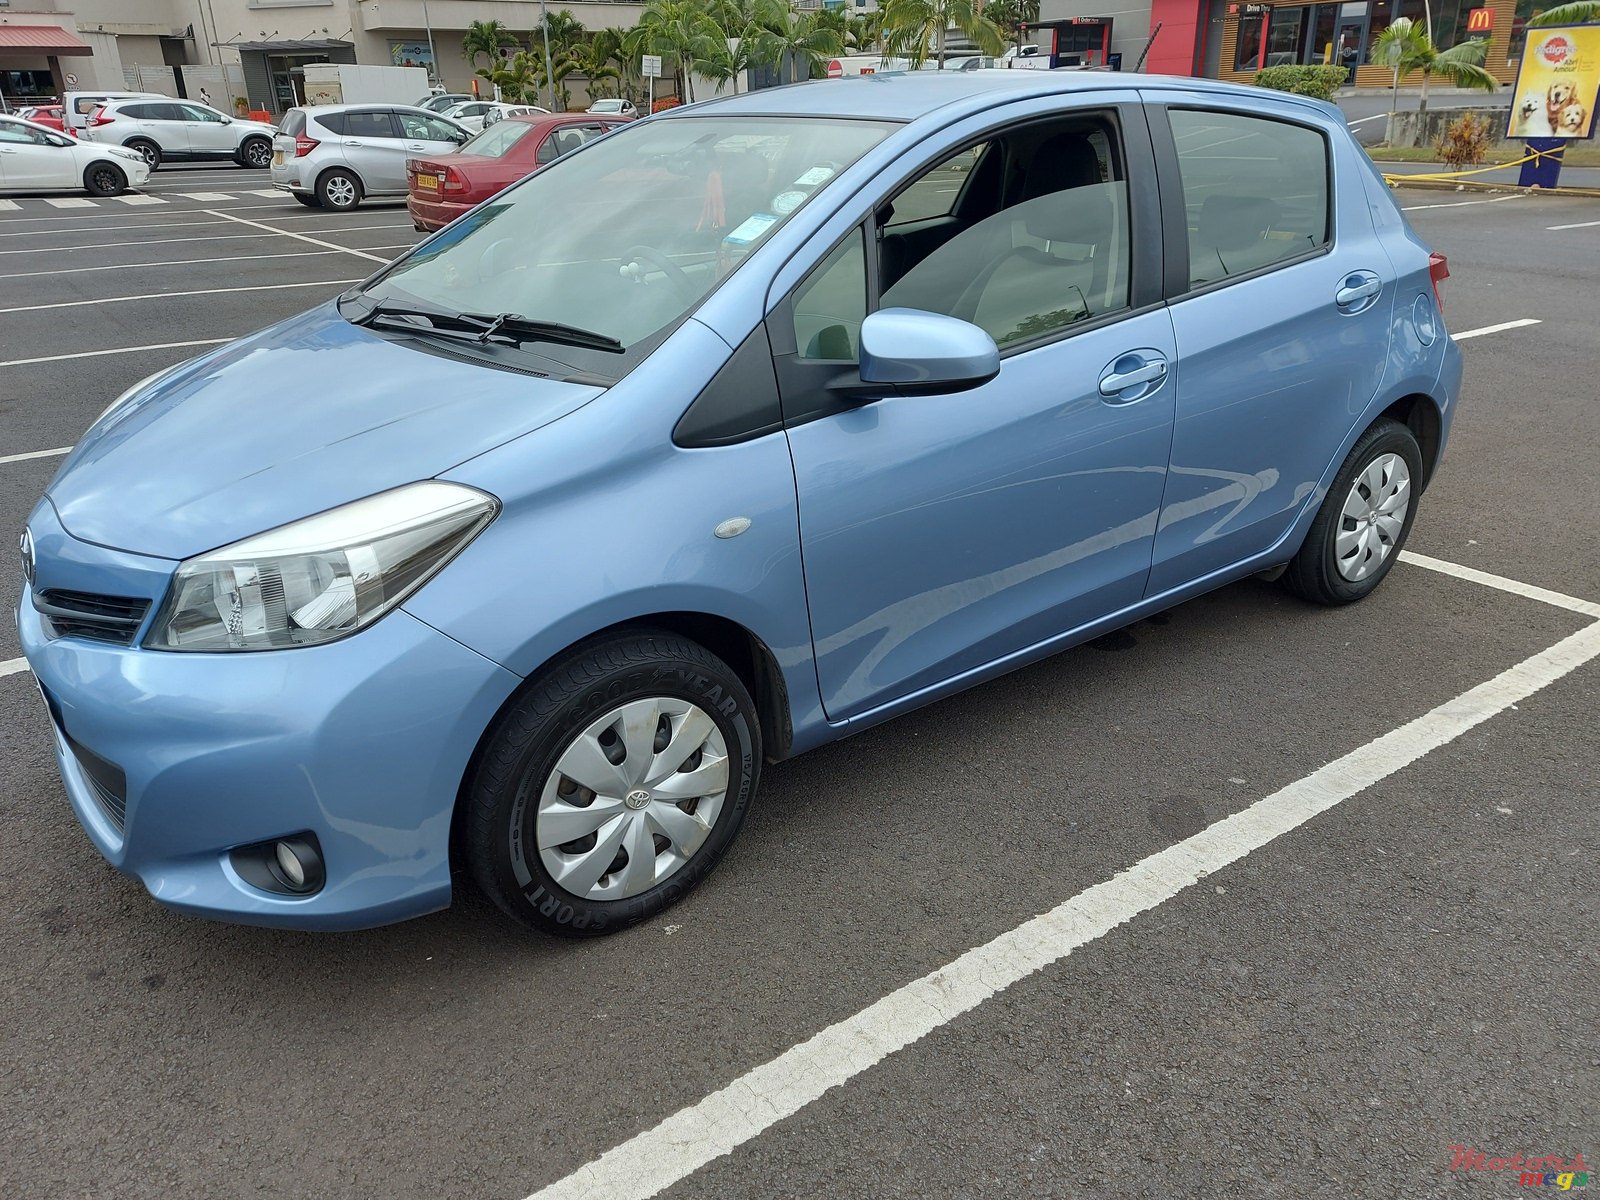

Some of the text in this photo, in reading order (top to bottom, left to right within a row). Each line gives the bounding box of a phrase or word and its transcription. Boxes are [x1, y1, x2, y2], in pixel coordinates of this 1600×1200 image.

[1246, 4, 1270, 12] Drive Thru
[678, 670, 738, 718] YEAR
[524, 884, 609, 930] SPORT
